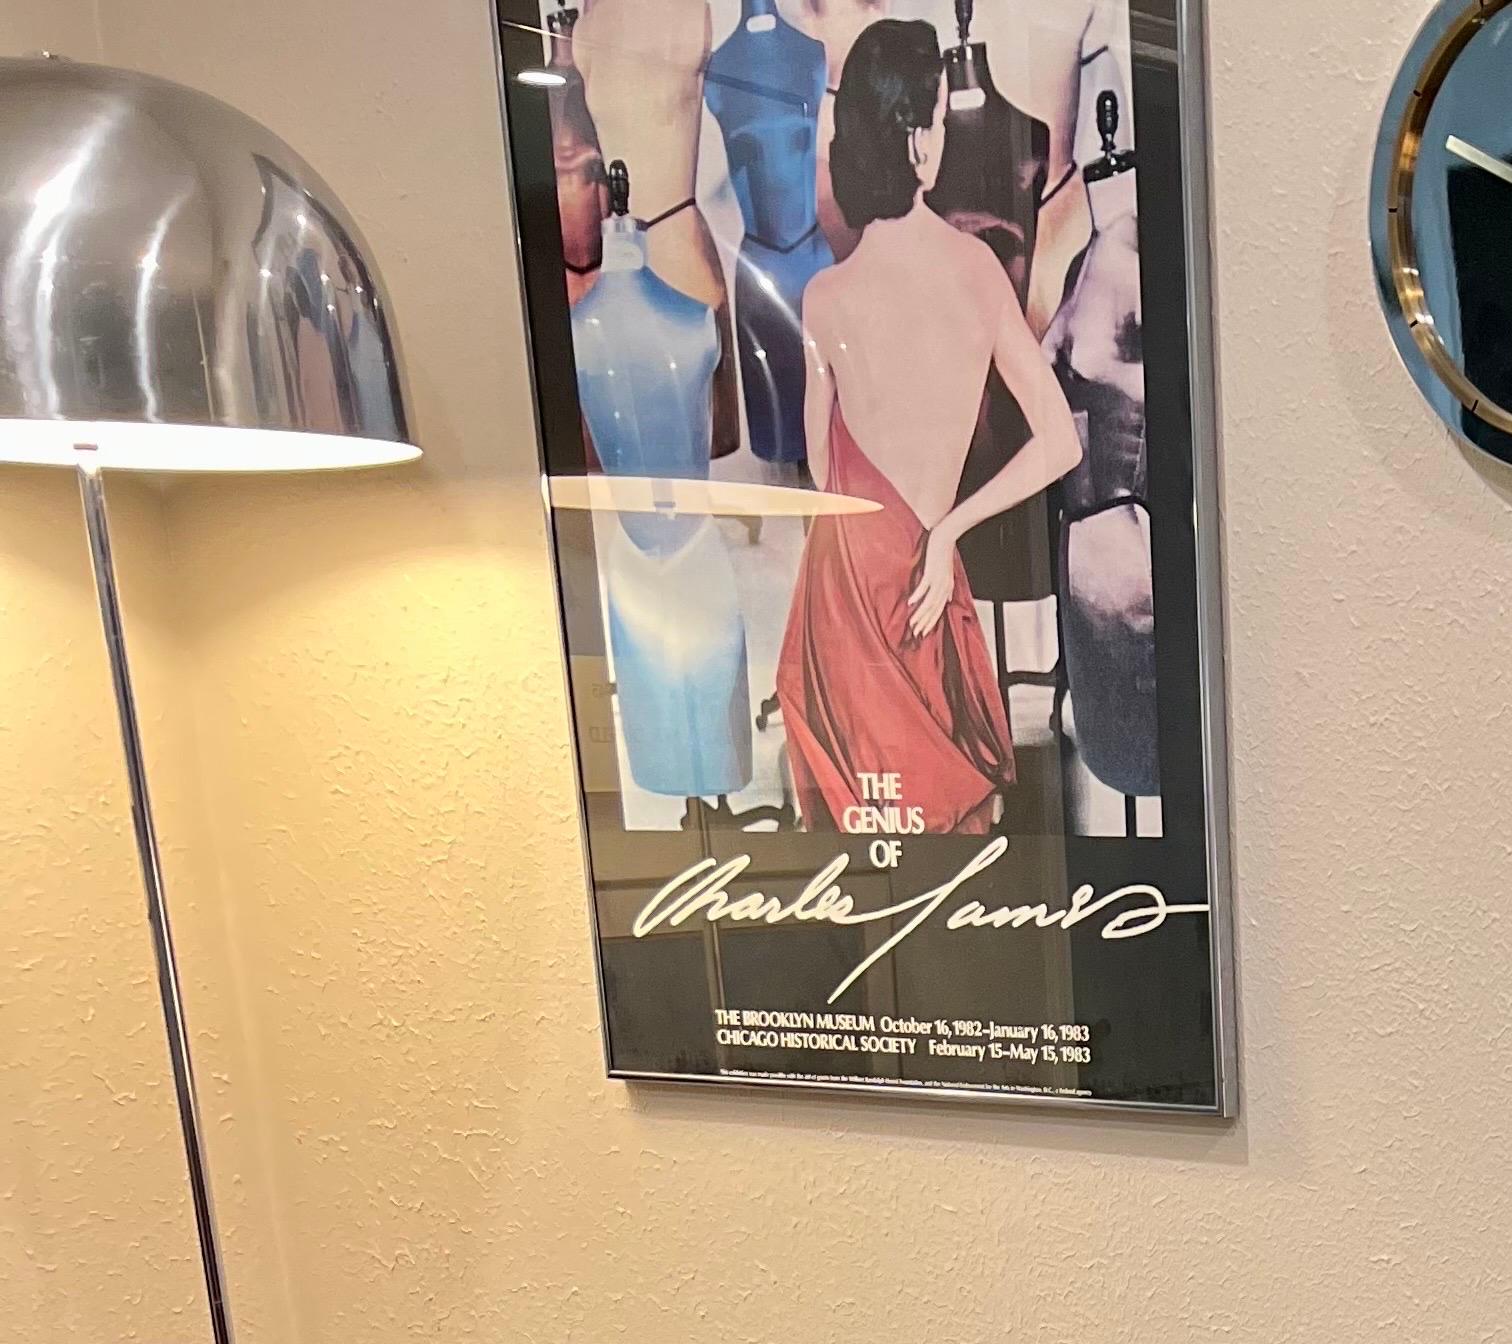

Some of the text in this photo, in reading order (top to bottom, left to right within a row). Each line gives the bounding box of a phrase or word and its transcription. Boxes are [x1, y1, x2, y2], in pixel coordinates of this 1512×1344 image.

[857, 772, 902, 800] THE
[843, 806, 925, 834] GENIUS
[869, 840, 902, 868] OF
[715, 1009, 740, 1026] THE
[743, 1011, 814, 1029] BROOKLYN
[816, 1014, 875, 1031] MUSEUM
[880, 1016, 932, 1034] October
[1059, 1025, 1090, 1042] 1983
[717, 1029, 779, 1047] CHICAGO
[780, 1032, 858, 1051] HISTORICAL
[860, 1036, 917, 1054] SOCIETY
[929, 1039, 985, 1062] February
[1059, 1047, 1091, 1063] 1983
